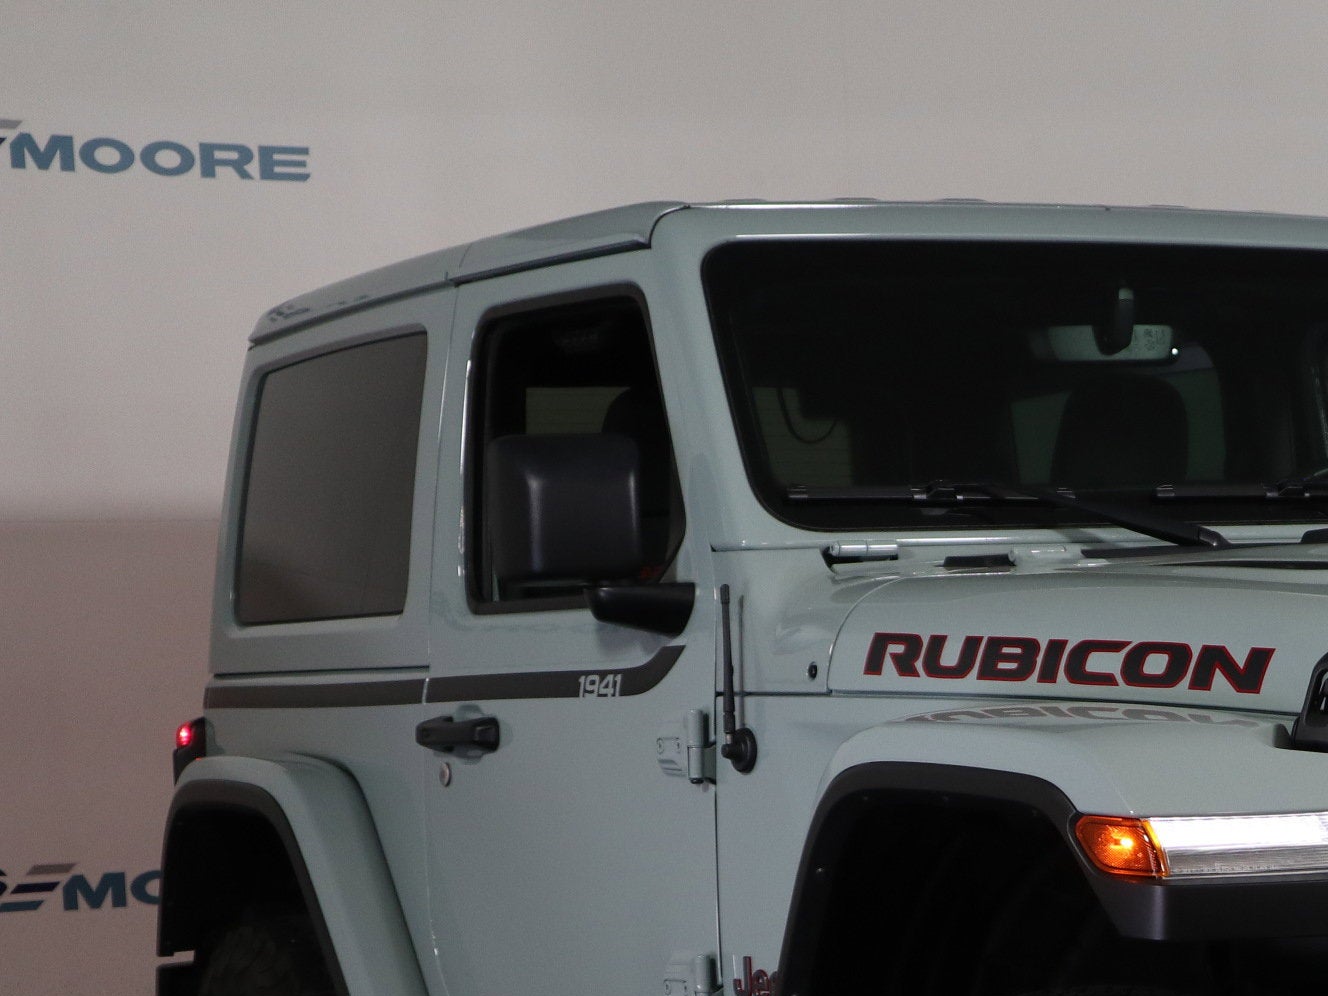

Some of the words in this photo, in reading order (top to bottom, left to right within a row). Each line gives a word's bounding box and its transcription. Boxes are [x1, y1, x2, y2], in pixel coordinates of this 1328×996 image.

[9, 131, 311, 182] MOORE
[578, 673, 622, 698] 1941
[863, 632, 1276, 694] RUBICON
